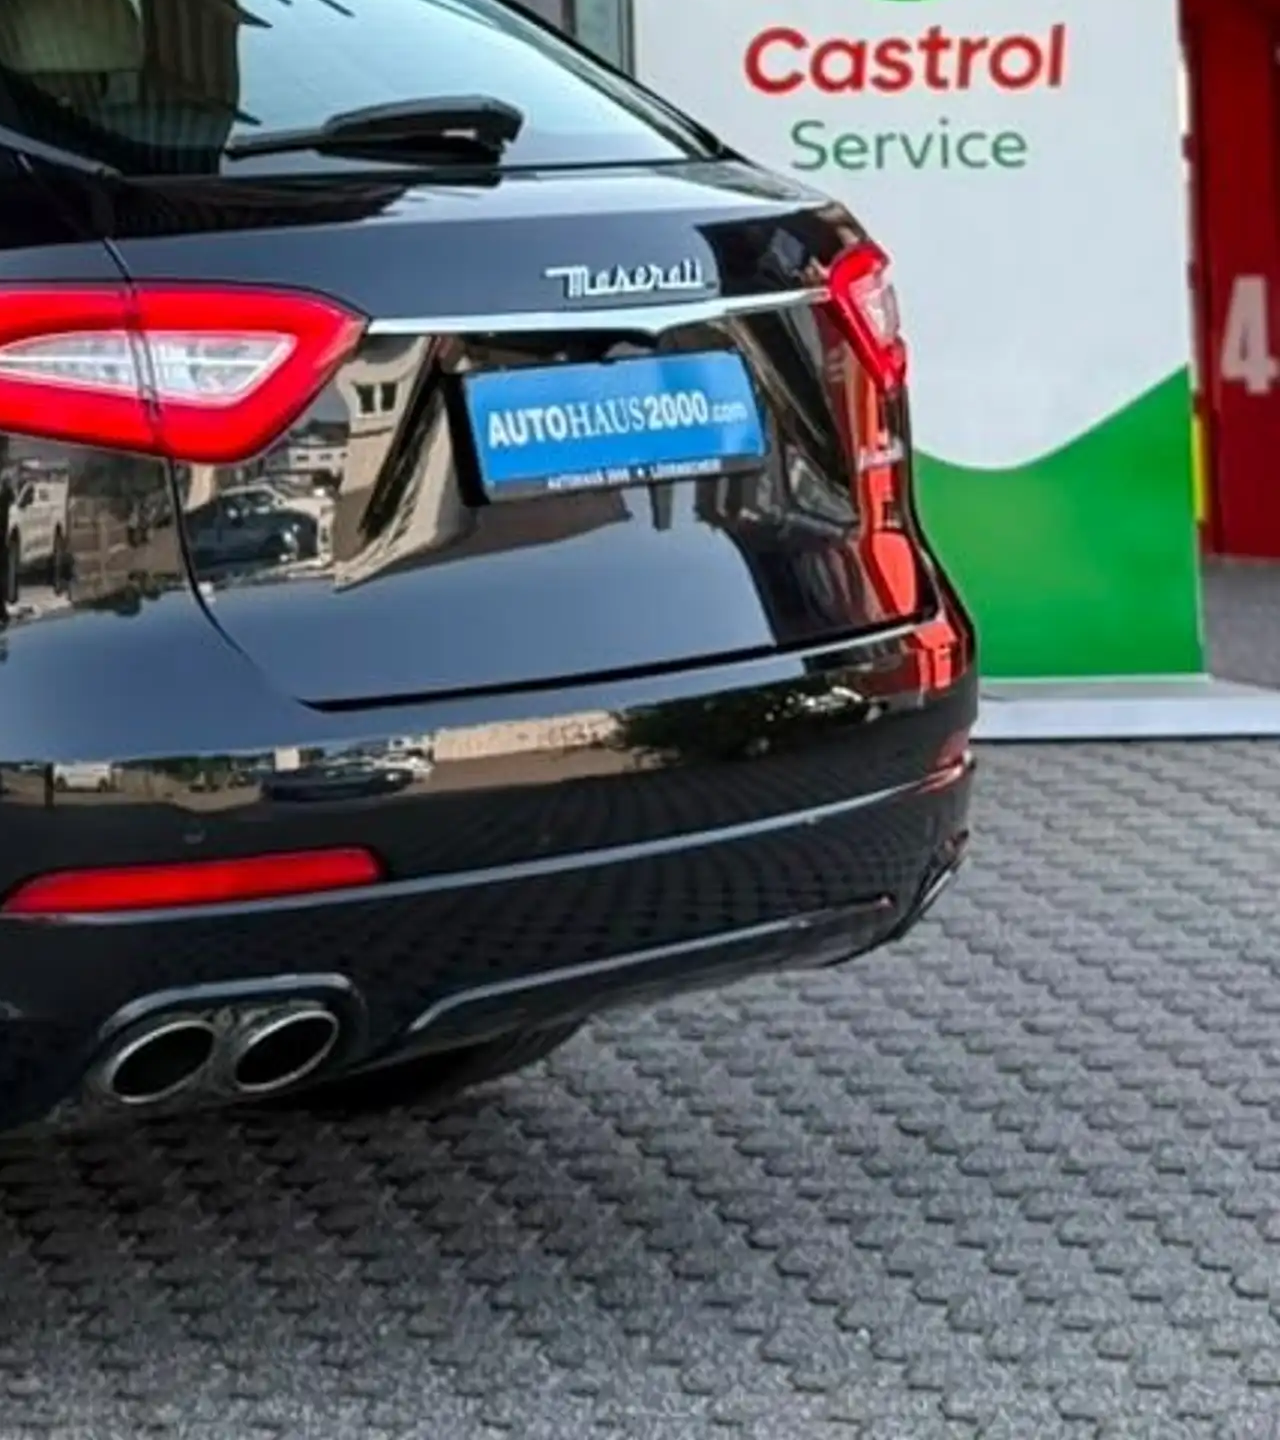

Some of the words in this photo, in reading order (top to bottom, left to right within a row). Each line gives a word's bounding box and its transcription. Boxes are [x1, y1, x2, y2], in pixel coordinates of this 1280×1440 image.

[743, 22, 1067, 95] Castrol
[790, 116, 1028, 171] Service
[544, 257, 705, 299] Maserati
[1220, 274, 1280, 395] 4
